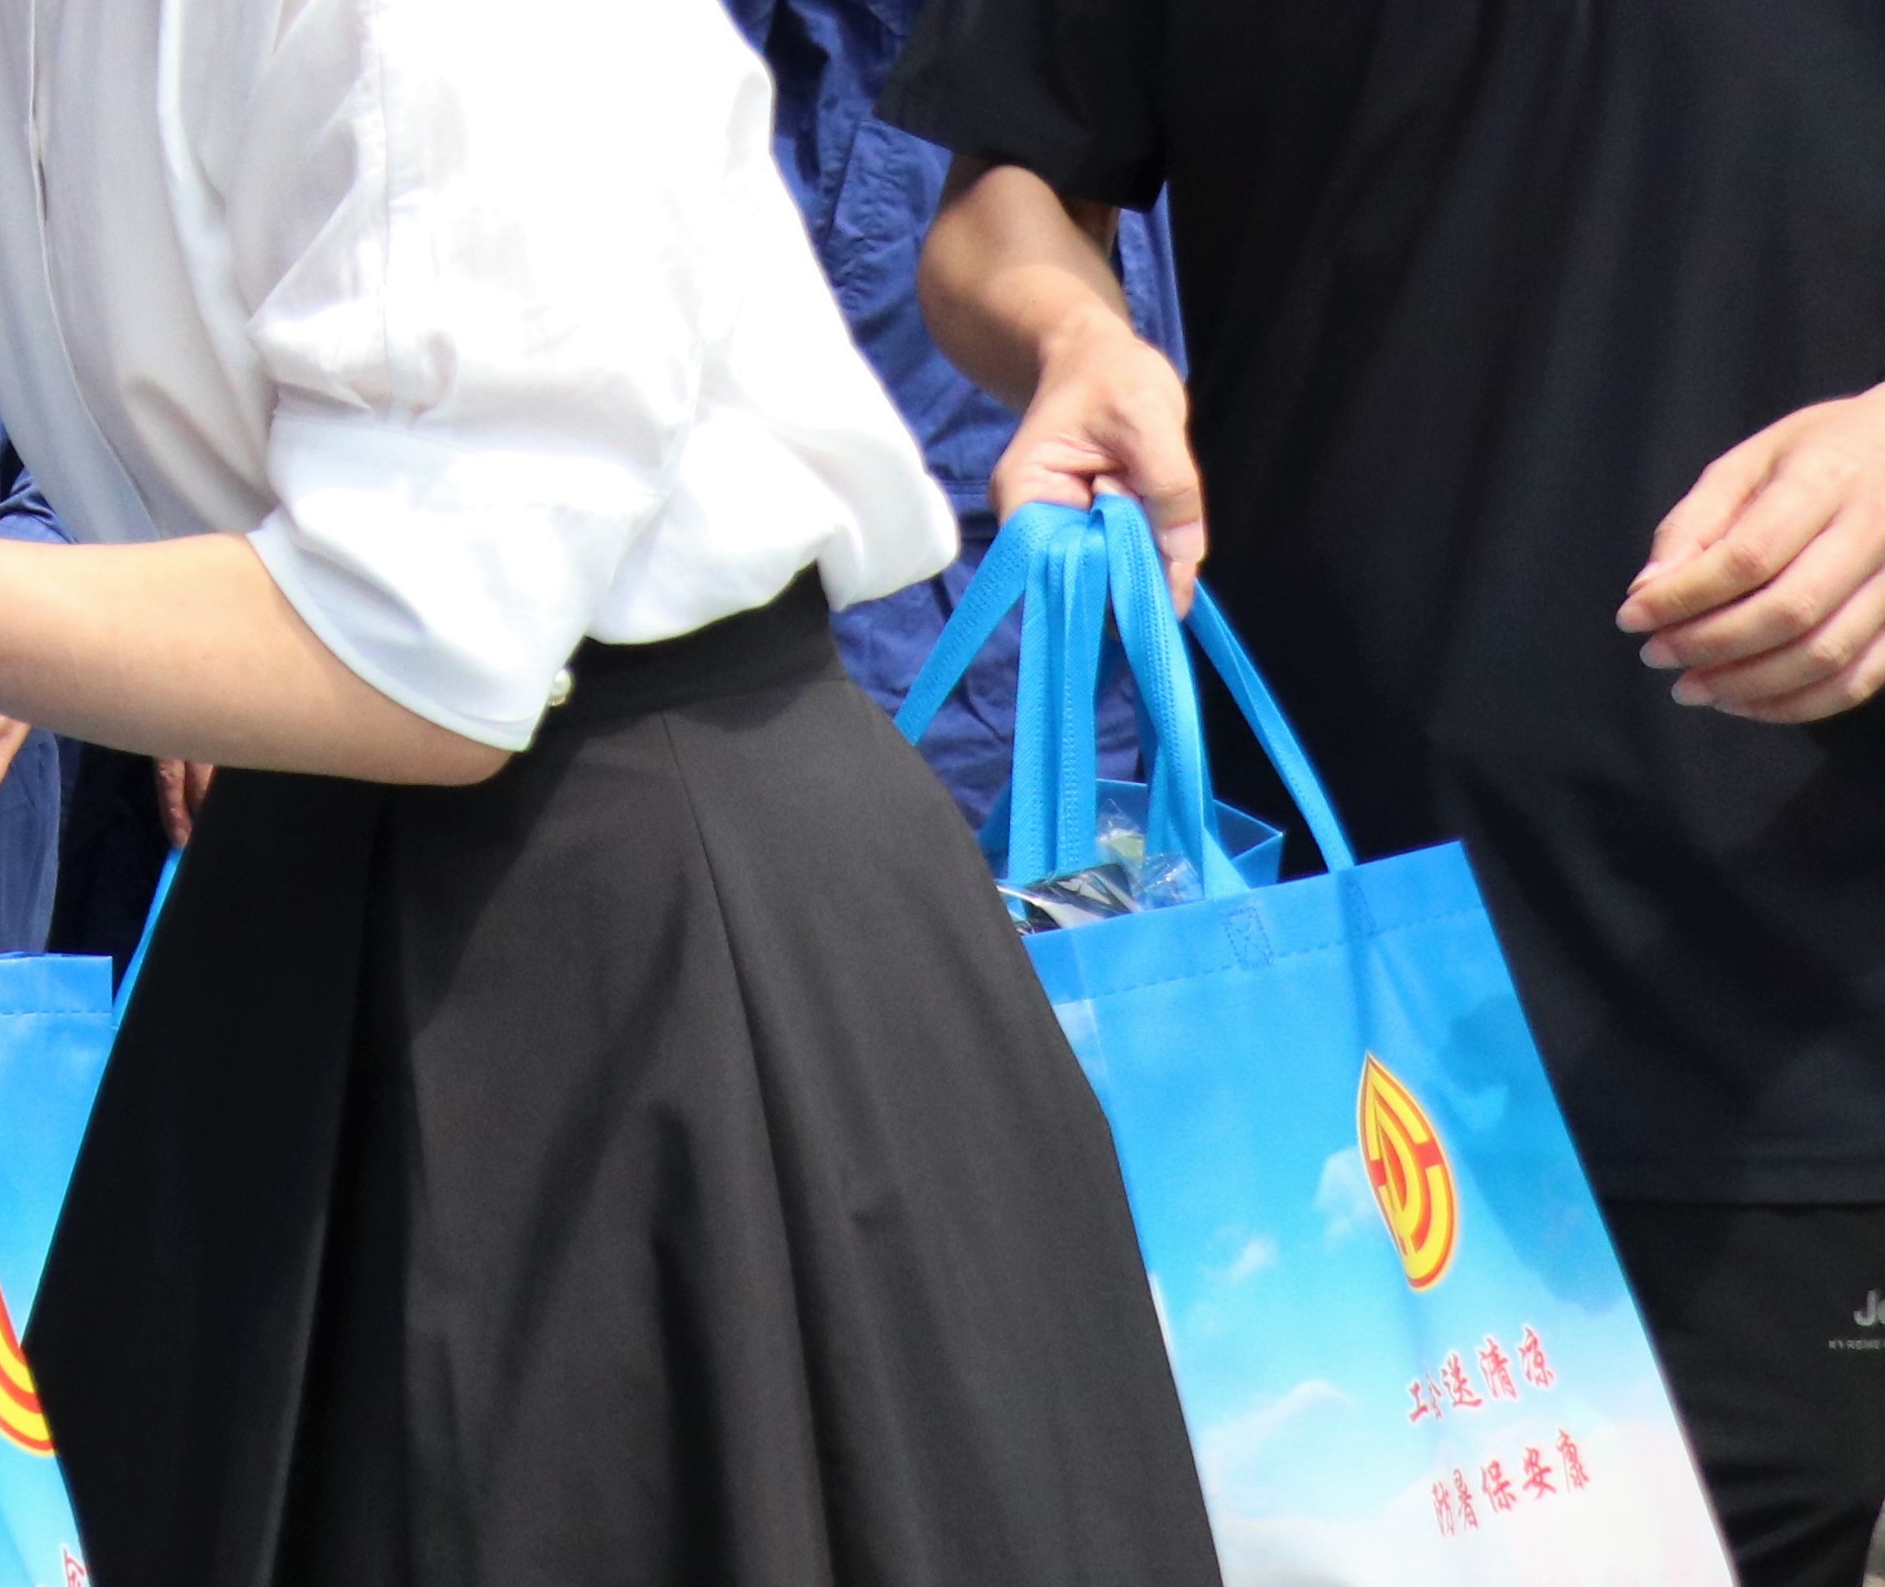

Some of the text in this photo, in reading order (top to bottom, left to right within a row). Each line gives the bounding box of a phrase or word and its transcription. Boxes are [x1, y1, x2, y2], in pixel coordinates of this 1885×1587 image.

[1431, 1428, 1590, 1537] 防暑保安康
